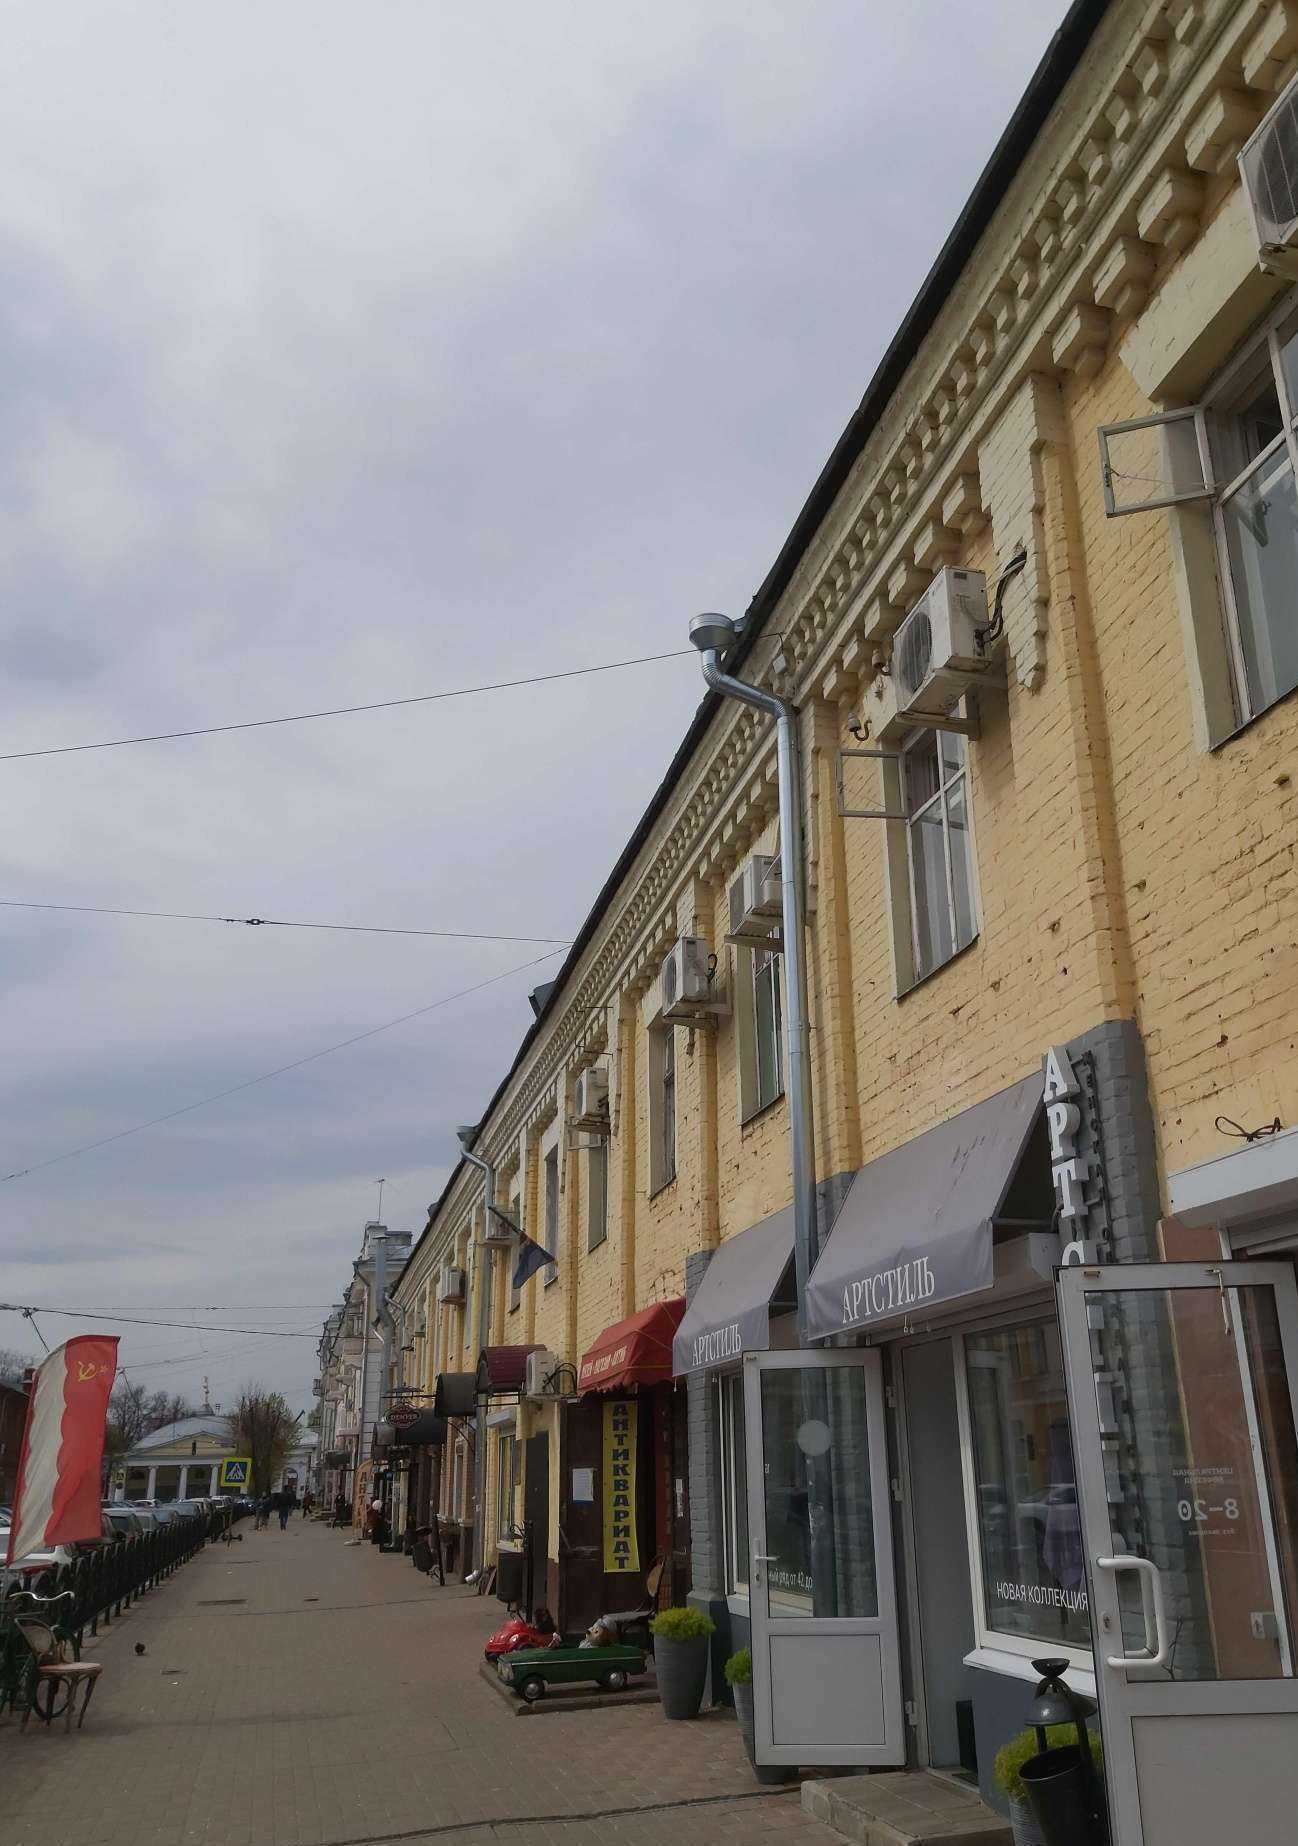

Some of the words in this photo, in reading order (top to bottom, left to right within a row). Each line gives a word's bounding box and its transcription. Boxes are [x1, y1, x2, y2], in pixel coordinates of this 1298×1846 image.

[842, 1256, 935, 1324] АРТСТИЛЬ
[692, 1323, 742, 1366] АРТСТИЛЬ
[612, 1403, 630, 1570] АНТИКВАРИАТ
[996, 1581, 1027, 1601] НОВАЯ
[1028, 1585, 1089, 1613] КОЛЛЕКЦИЯ
